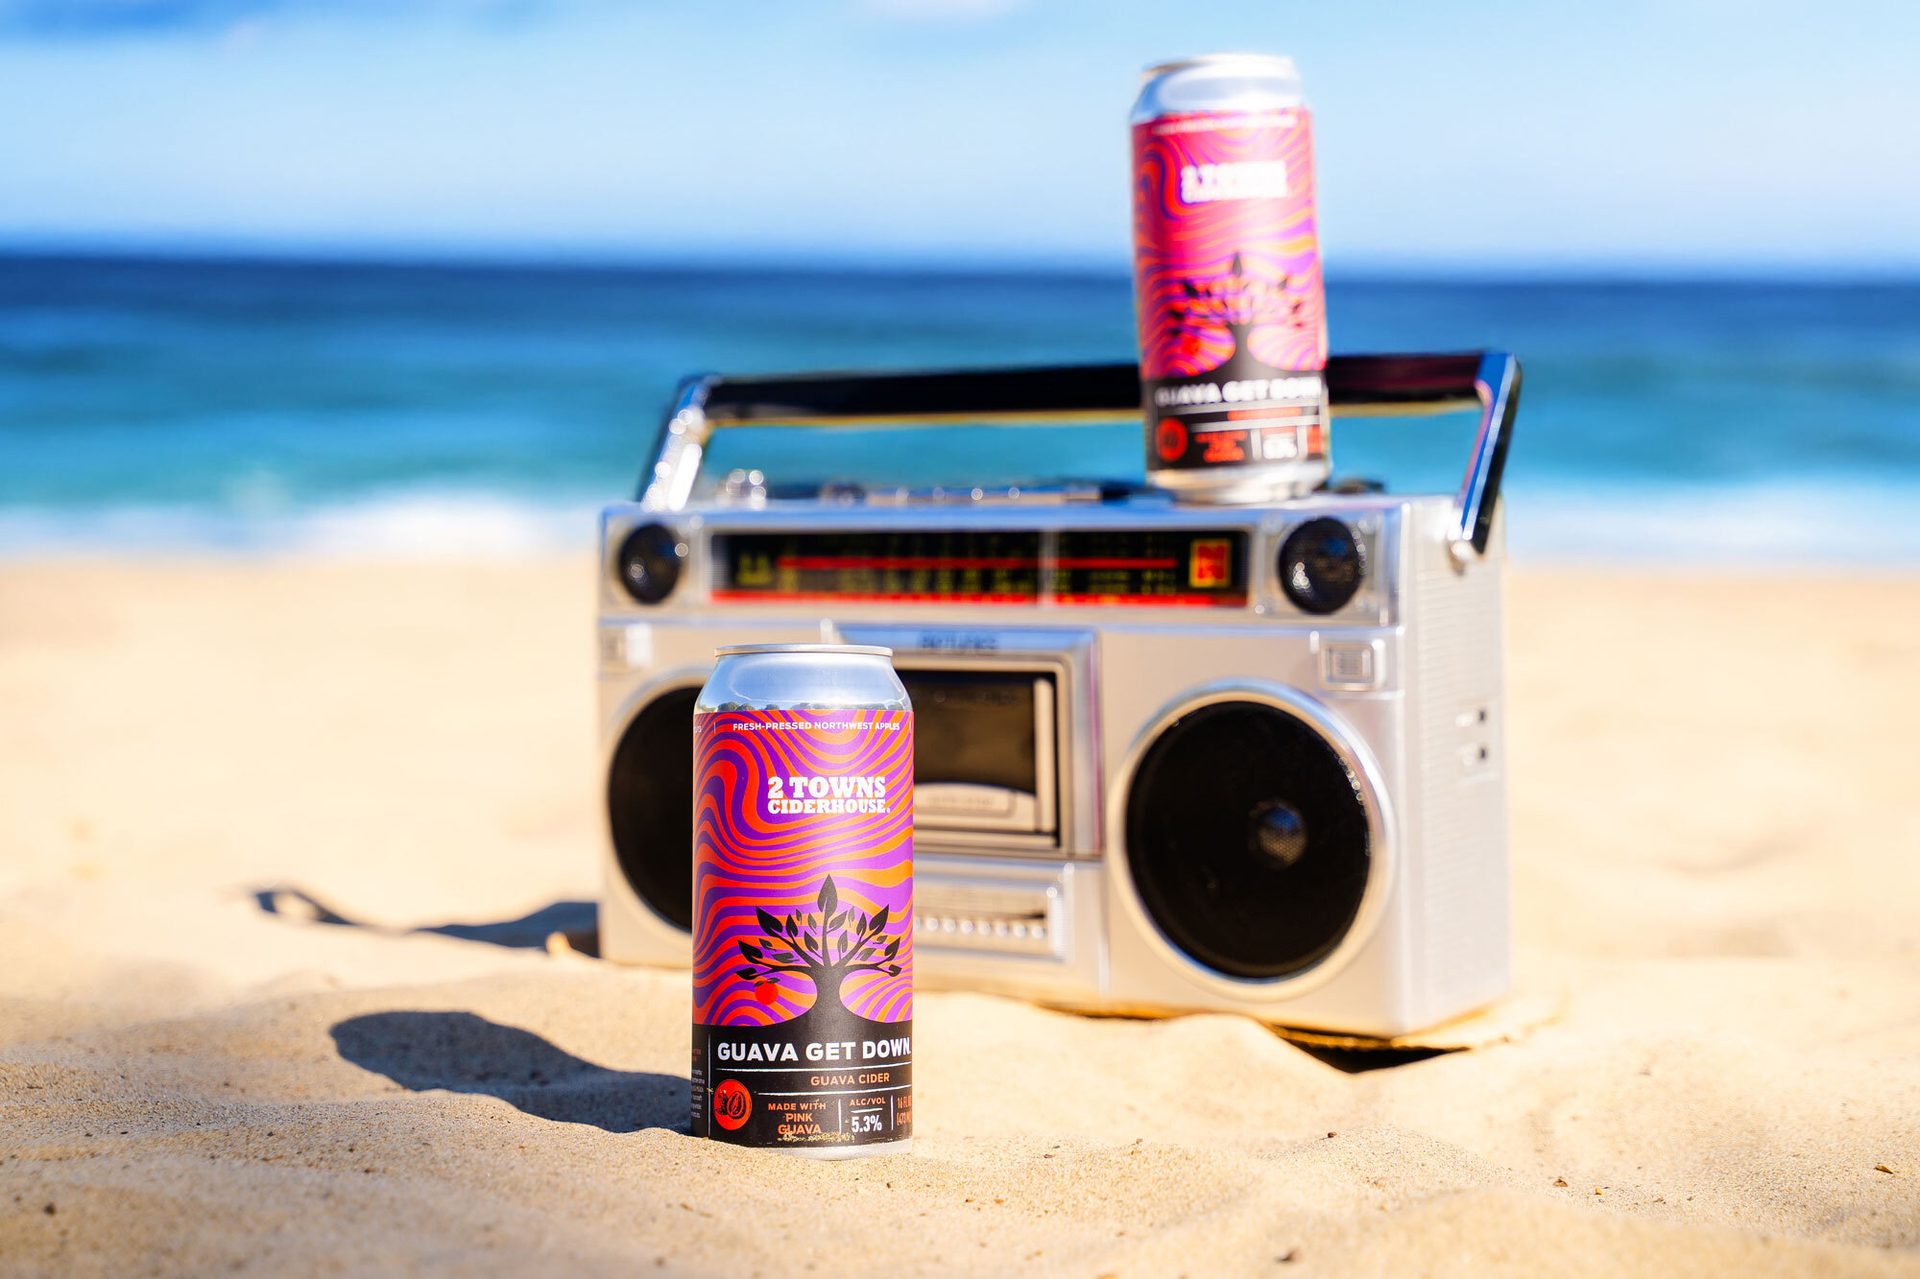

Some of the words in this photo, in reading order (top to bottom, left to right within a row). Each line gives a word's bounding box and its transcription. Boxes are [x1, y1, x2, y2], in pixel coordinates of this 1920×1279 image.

[733, 722, 811, 731] FRESH-PRESSED
[814, 721, 873, 730] NORTHWEST
[874, 722, 900, 731] APPLES
[768, 776, 783, 799] 2
[789, 776, 886, 798] TOWNS
[717, 1042, 799, 1062] GUAVA
[806, 1041, 857, 1061] GET
[810, 1074, 855, 1086] GUAVA
[858, 1072, 890, 1084] CIDER
[849, 1097, 886, 1106] ALC/VOL
[768, 1103, 797, 1111] MADE
[800, 1103, 827, 1111] WITH
[785, 1113, 813, 1122] PINK
[851, 1115, 882, 1132] 5.3%
[778, 1124, 822, 1134] GUAVA
